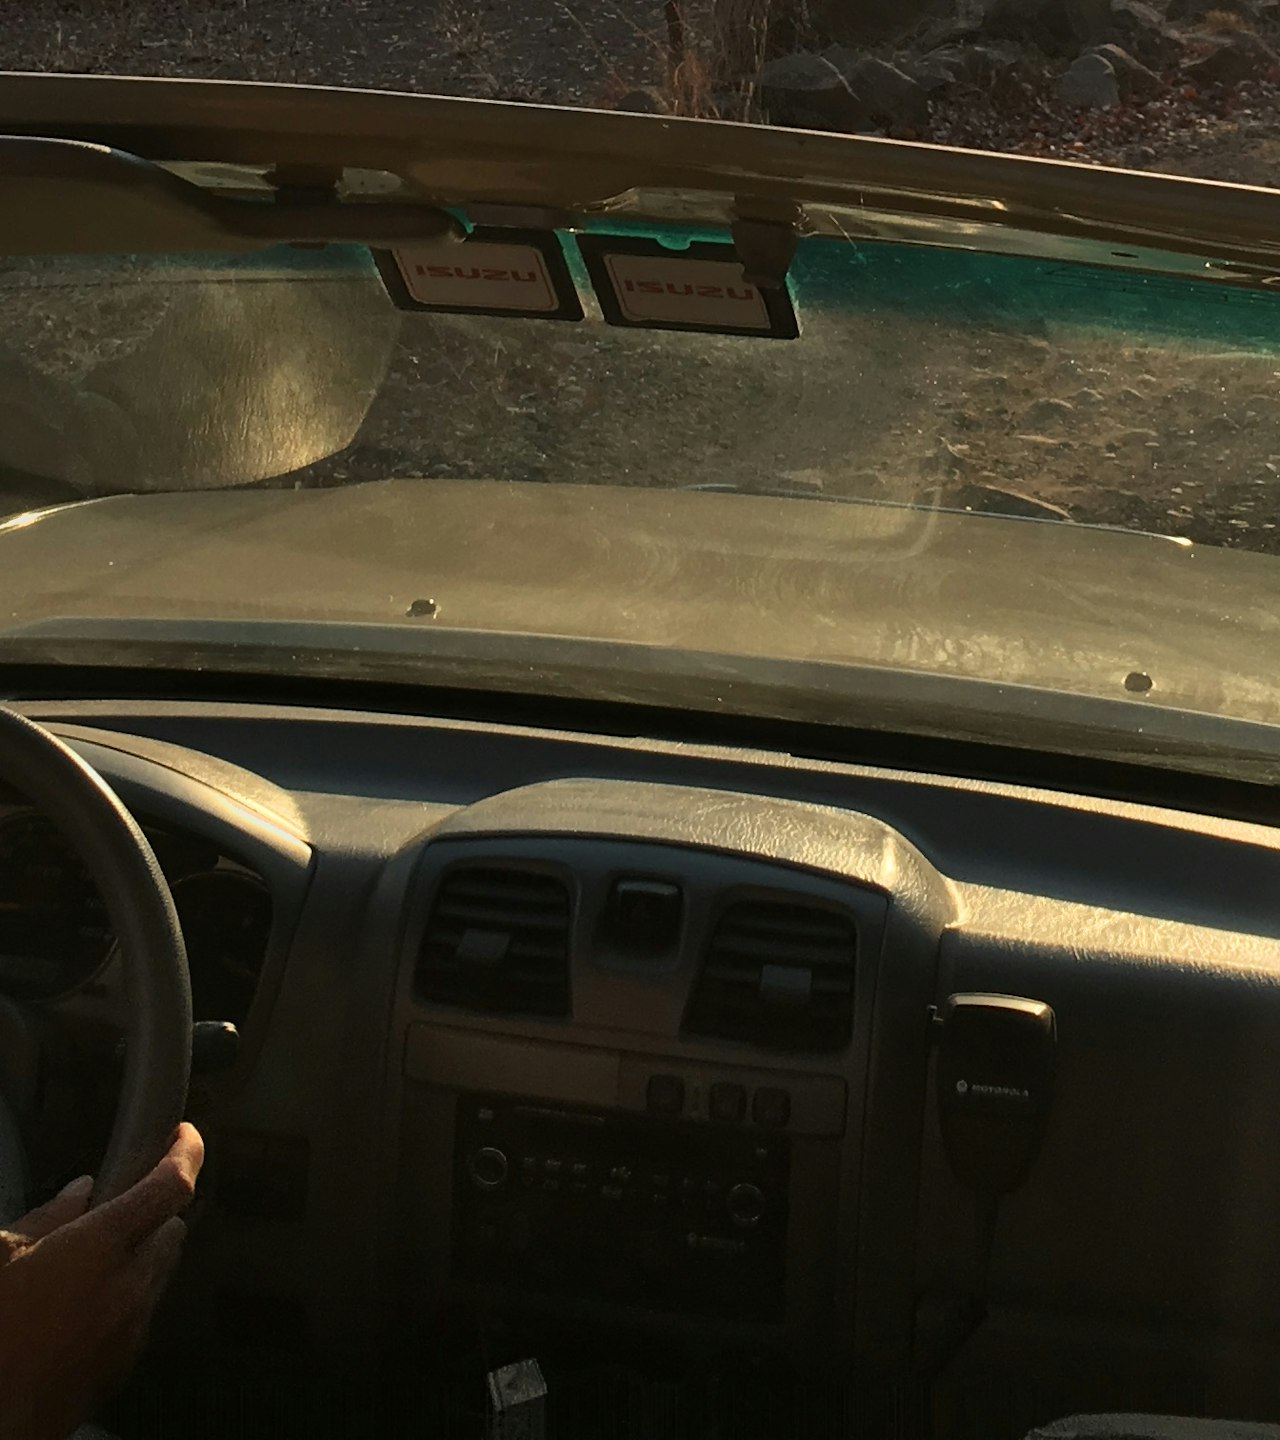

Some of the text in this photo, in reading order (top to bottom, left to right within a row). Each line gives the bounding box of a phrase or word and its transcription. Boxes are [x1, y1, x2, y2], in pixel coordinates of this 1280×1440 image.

[415, 264, 537, 281] ISUZU
[623, 279, 754, 300] ISUZU
[971, 1083, 1030, 1097] MOTOROLA
